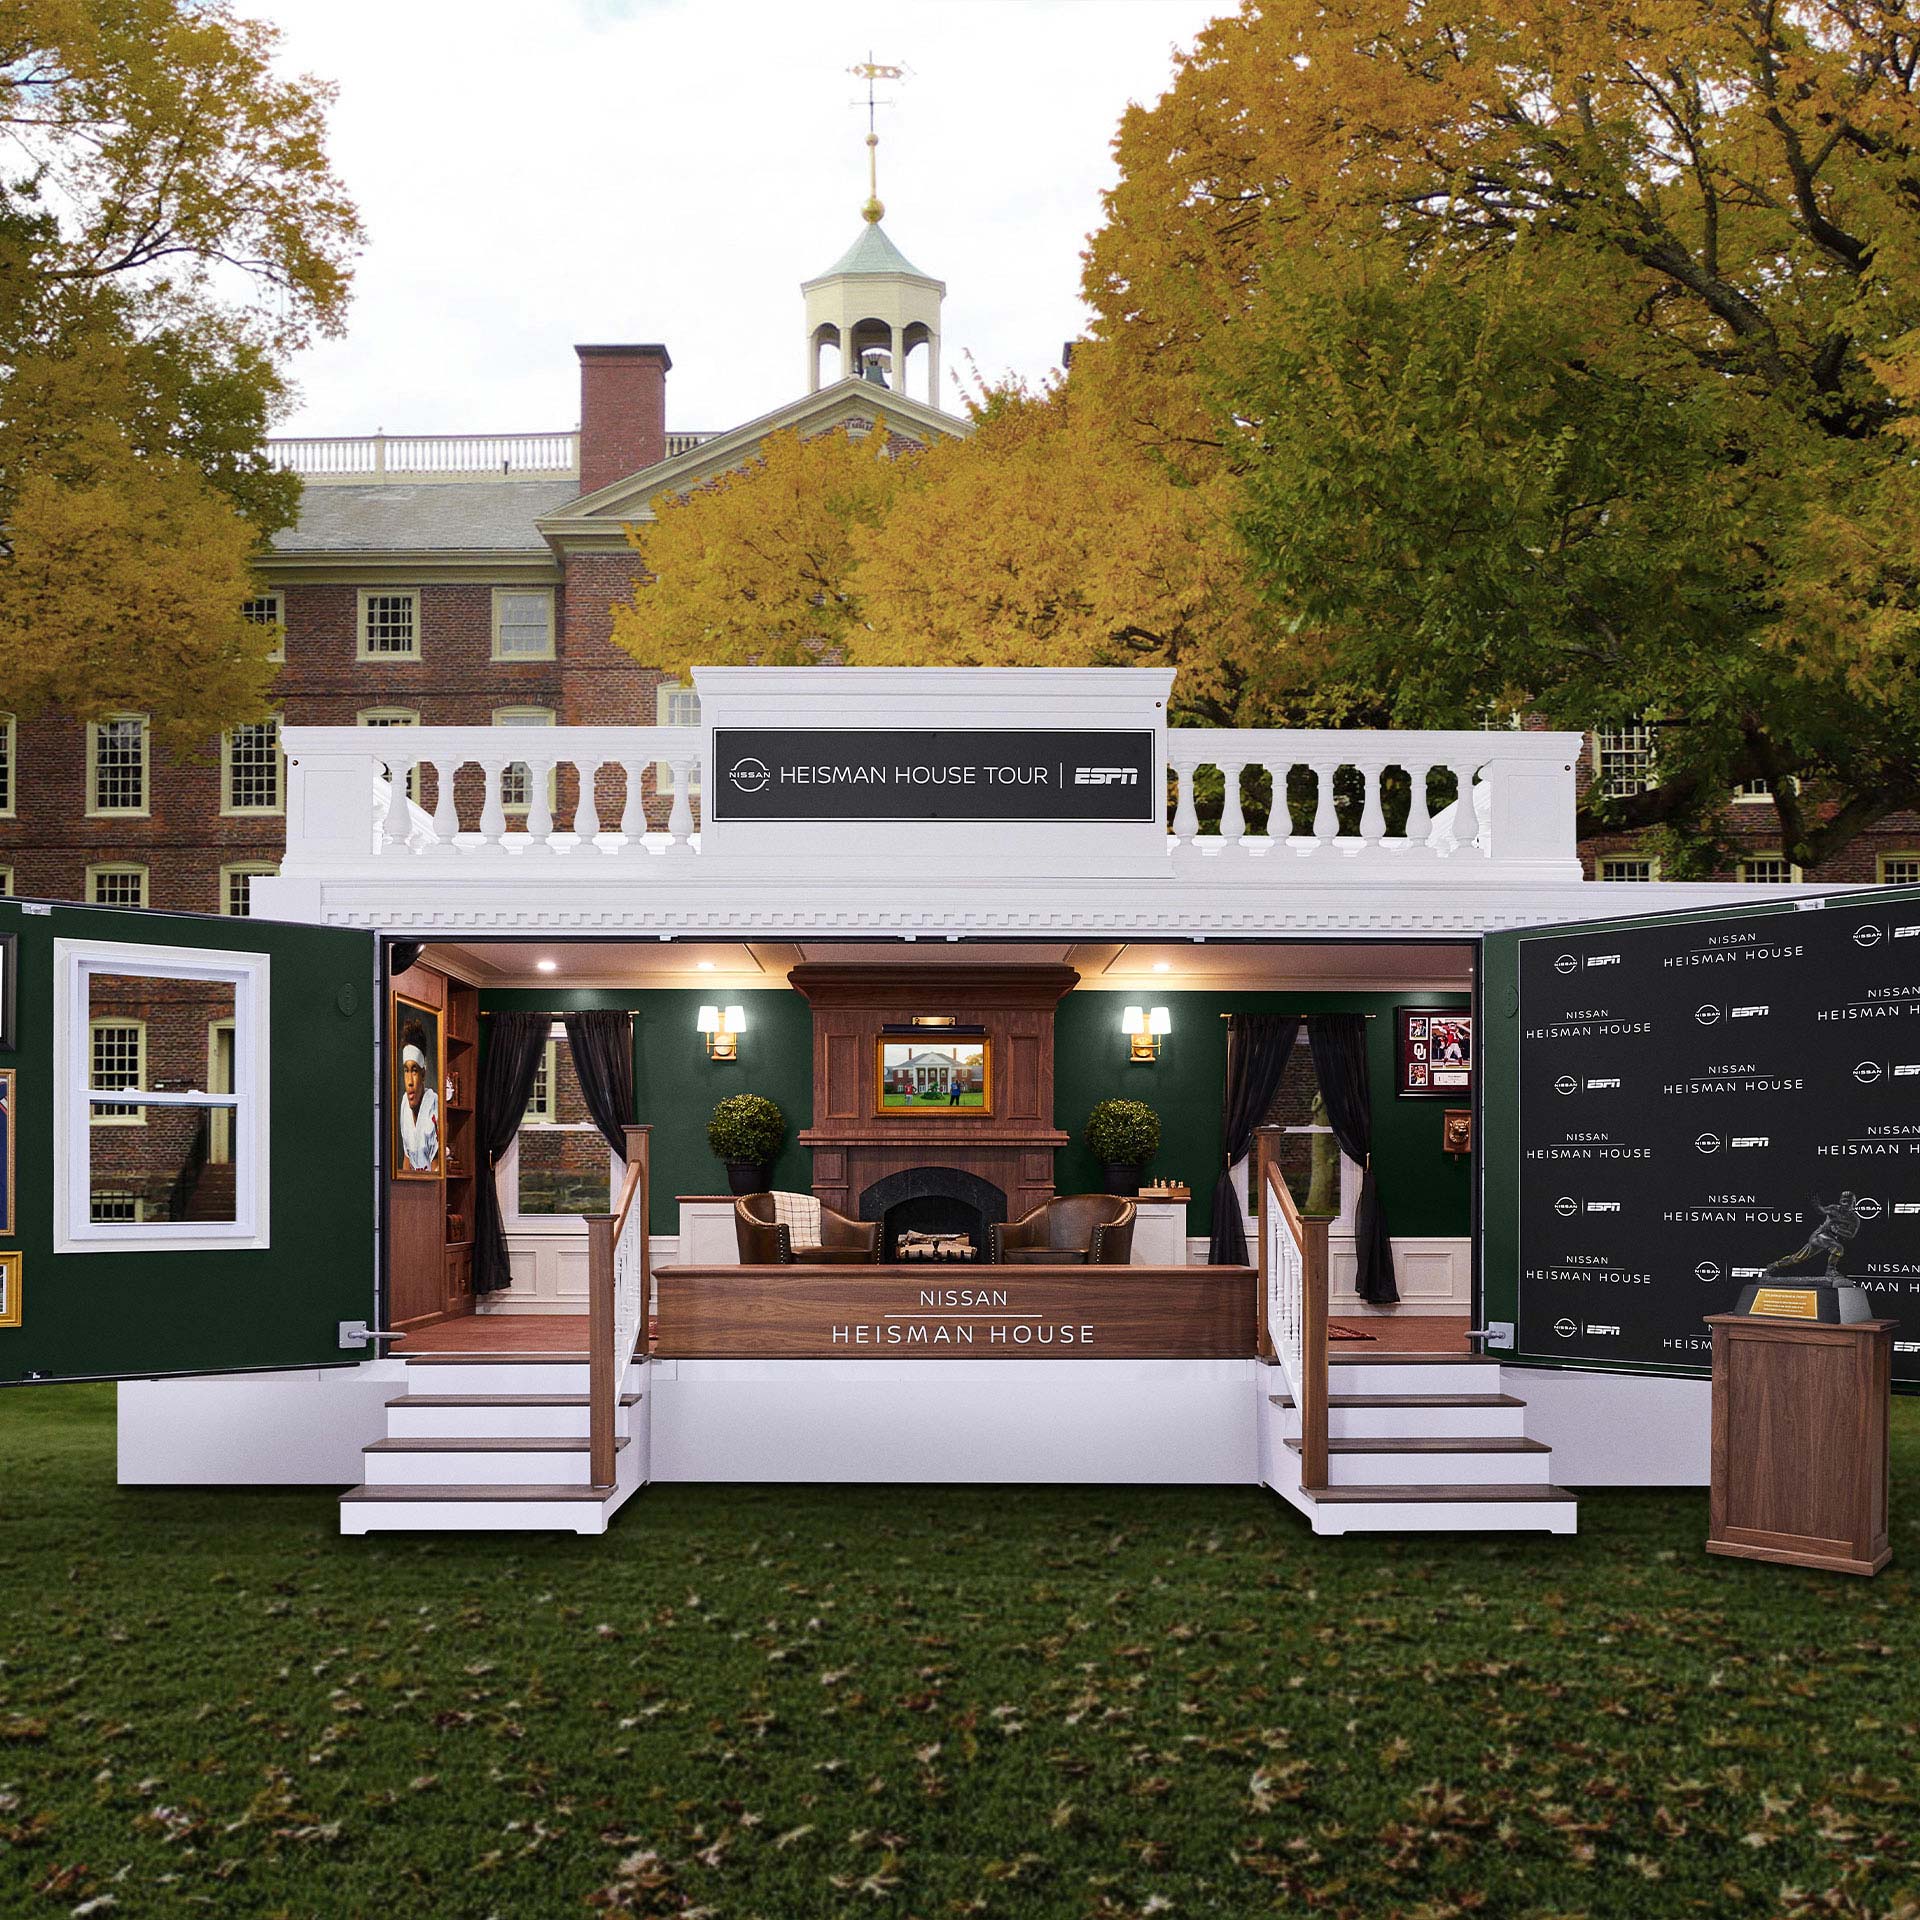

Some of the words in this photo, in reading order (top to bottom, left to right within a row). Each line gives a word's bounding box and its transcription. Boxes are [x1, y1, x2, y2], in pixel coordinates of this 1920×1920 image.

[781, 766, 886, 784] HEISMAN
[895, 766, 976, 784] HOUSE
[984, 766, 1048, 784] TOUR
[1075, 767, 1138, 785] ESPN
[1708, 932, 1757, 945] NISSAN
[1587, 954, 1621, 967] ESPN
[1664, 951, 1736, 967] HEISMAN
[1745, 945, 1803, 960] HOUSE
[1868, 986, 1920, 998] NISSAN
[1566, 1008, 1609, 1020] NISSAN
[1732, 1005, 1769, 1018] ESPN
[1817, 1005, 1899, 1020] HEISMAN
[1526, 1026, 1591, 1039] HEISMAN
[1599, 1022, 1651, 1035] HOUSE
[1708, 1064, 1756, 1074] NISSAN
[1587, 1078, 1621, 1089] ESPN
[1664, 1082, 1736, 1094] HEISMAN
[1745, 1079, 1803, 1091] HOUSE
[1868, 1125, 1920, 1135] NISSAN
[1566, 1132, 1609, 1142] NISSAN
[1732, 1136, 1769, 1147] ESPN
[1526, 1149, 1591, 1159] HEISMAN
[1599, 1148, 1651, 1159] HOUSE
[1817, 1144, 1899, 1156] HEISMAN
[1708, 1194, 1756, 1204] NISSAN
[1587, 1202, 1621, 1212] ESPN
[1664, 1211, 1736, 1222] HEISMAN
[1745, 1212, 1803, 1223] HOUSE
[1566, 1255, 1609, 1265] NISSAN
[1868, 1263, 1920, 1273] NISSAN
[1526, 1270, 1591, 1281] HEISMAN
[1599, 1272, 1651, 1284] HOUSE
[920, 1290, 1008, 1307] NISSAN
[832, 1325, 973, 1344] HEISMAN
[990, 1325, 1094, 1344] HOUSE
[1587, 1324, 1621, 1336] ESPN
[1663, 1338, 1711, 1350] HEISM
